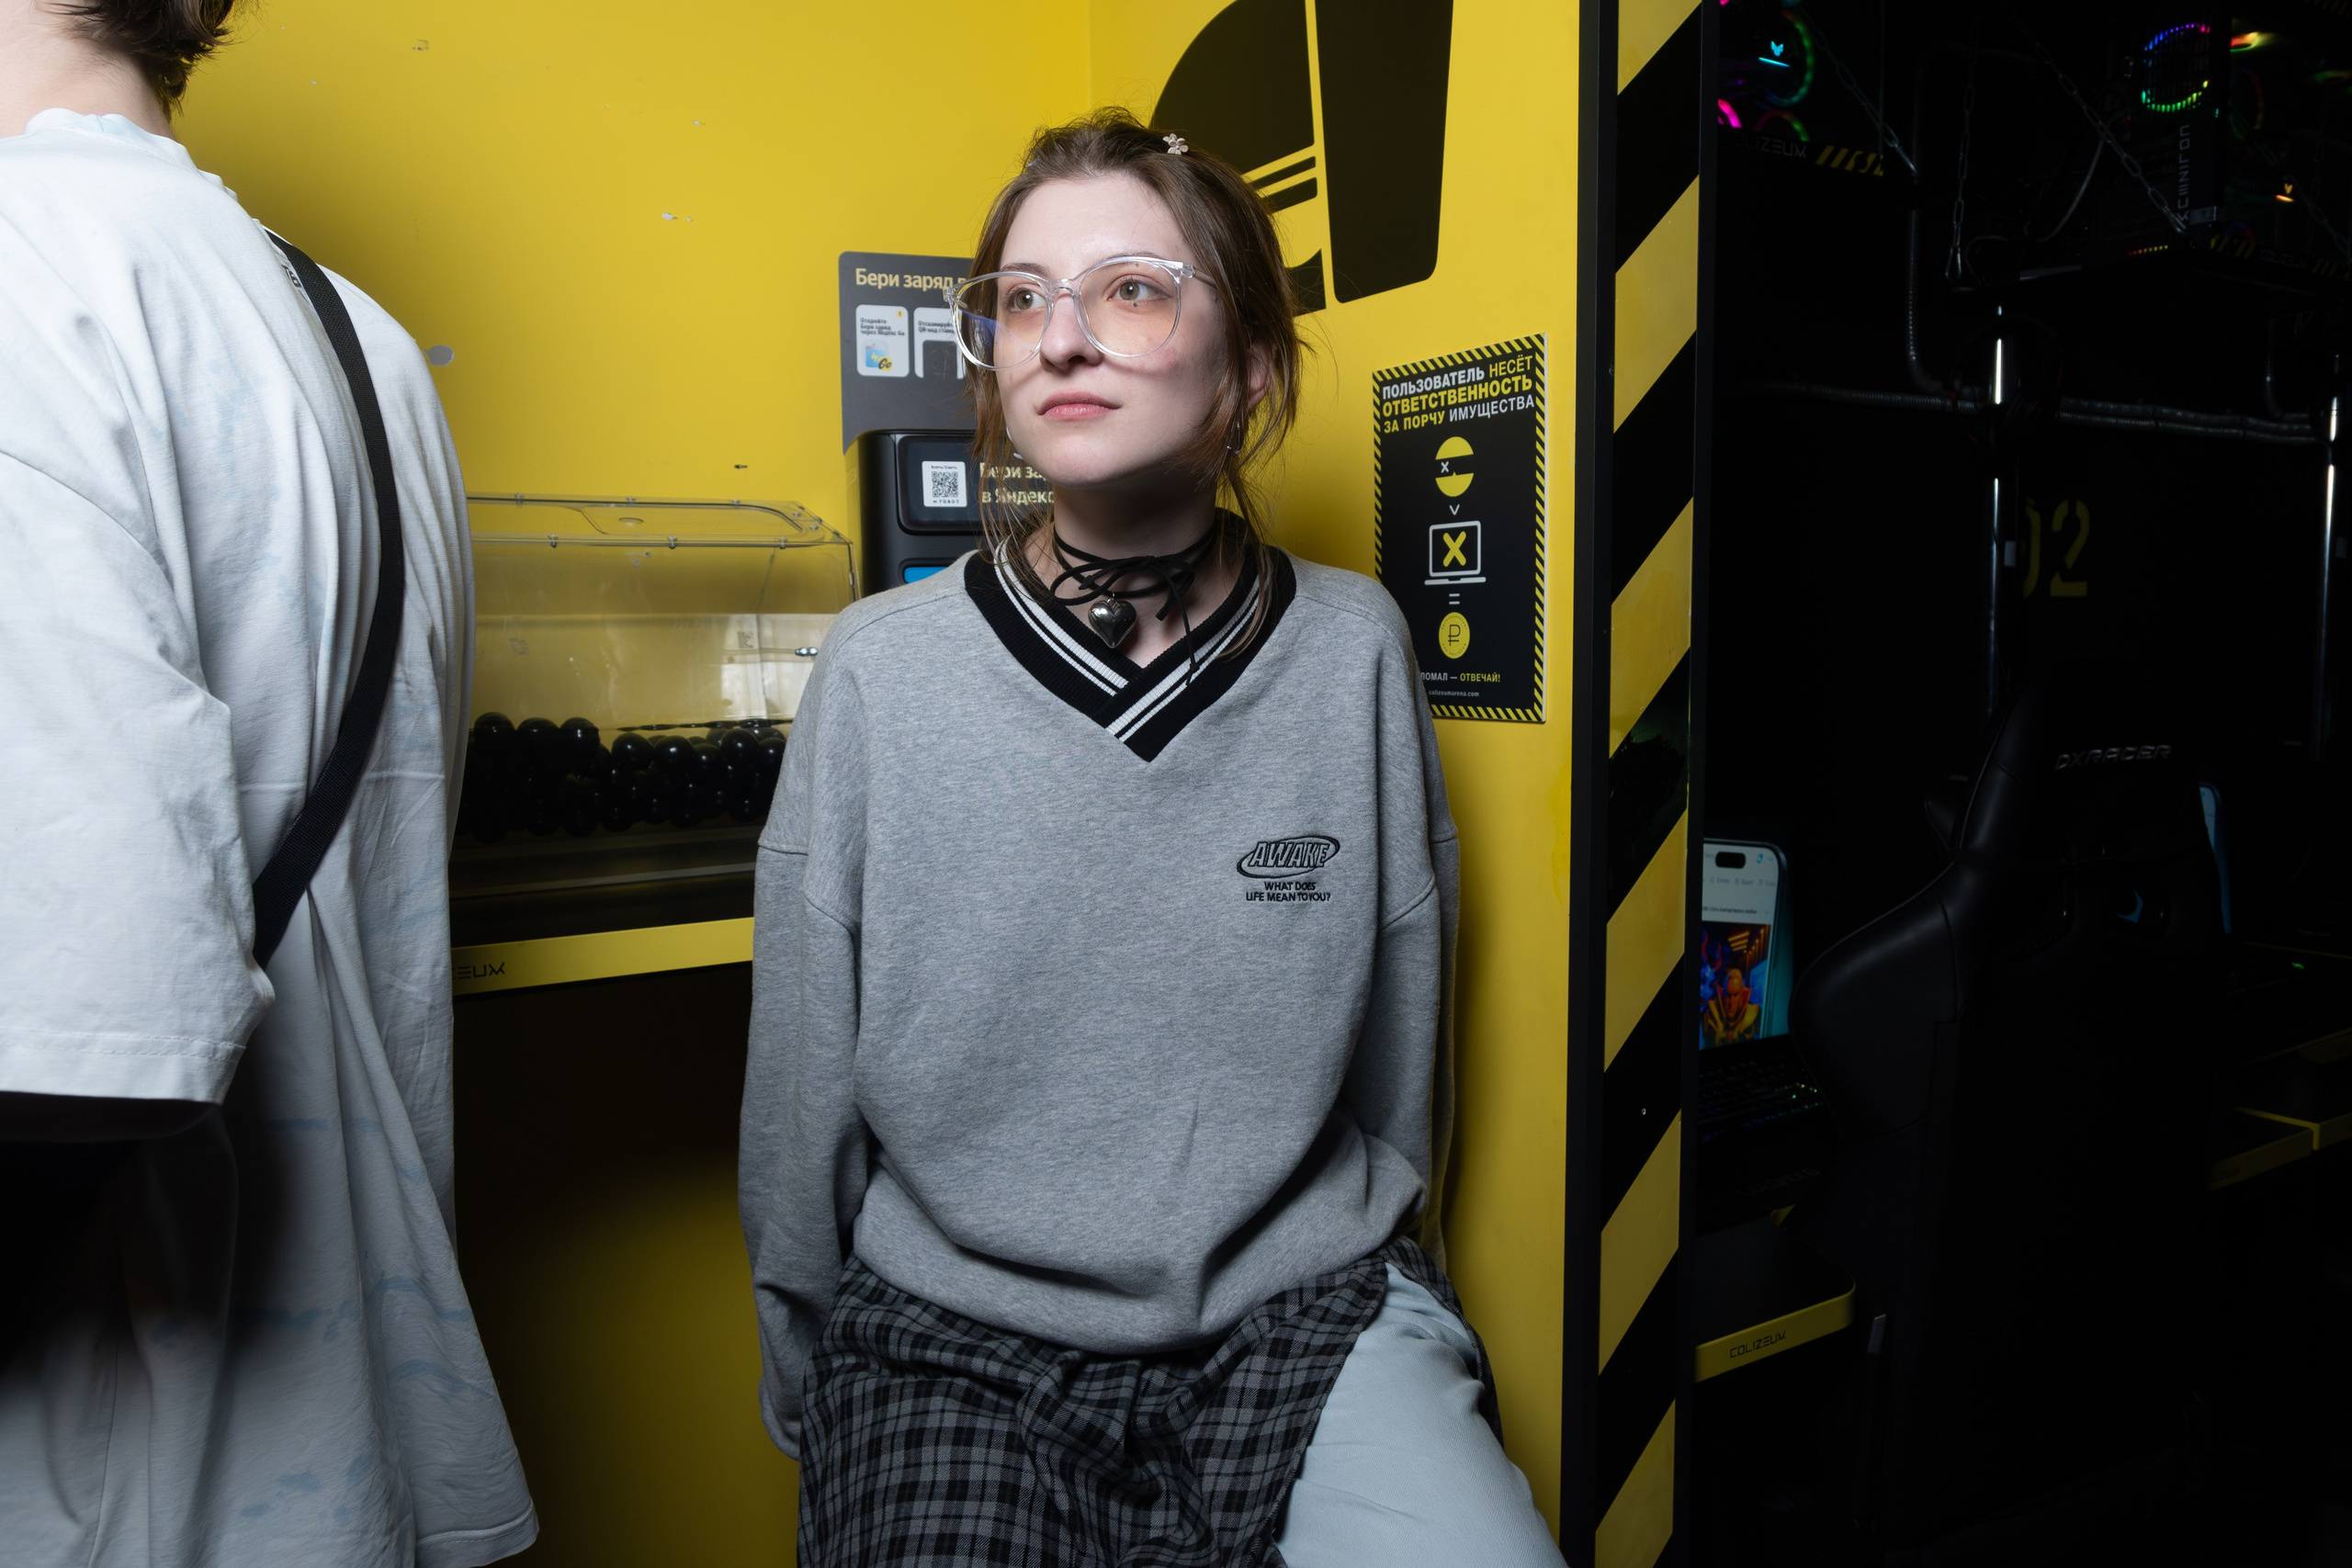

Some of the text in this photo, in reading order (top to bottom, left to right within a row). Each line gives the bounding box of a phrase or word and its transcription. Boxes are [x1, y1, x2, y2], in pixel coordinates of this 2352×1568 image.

[855, 267, 899, 289] Бери
[1382, 354, 1533, 400] ПОЛЬЗОВАТЕЛЬ НЕСЁТ
[1382, 374, 1533, 418] ОТВЕТСТВЕННОСТЬ
[1384, 394, 1535, 434] ЗА ПОРЧУ ИМУЩЕСТВА
[1421, 672, 1448, 682] ЛОМАЛ
[1459, 671, 1501, 683] ОТВЕЧАЙ!
[2054, 743, 2172, 772] DXRACER
[1247, 840, 1331, 869] AWAKE
[1246, 892, 1265, 902] LIFE
[1266, 892, 1296, 902] MEAN
[1264, 881, 1317, 891] WHAT DOES
[452, 962, 505, 980] EUM
[1730, 1330, 1786, 1359] COLIZEUM
